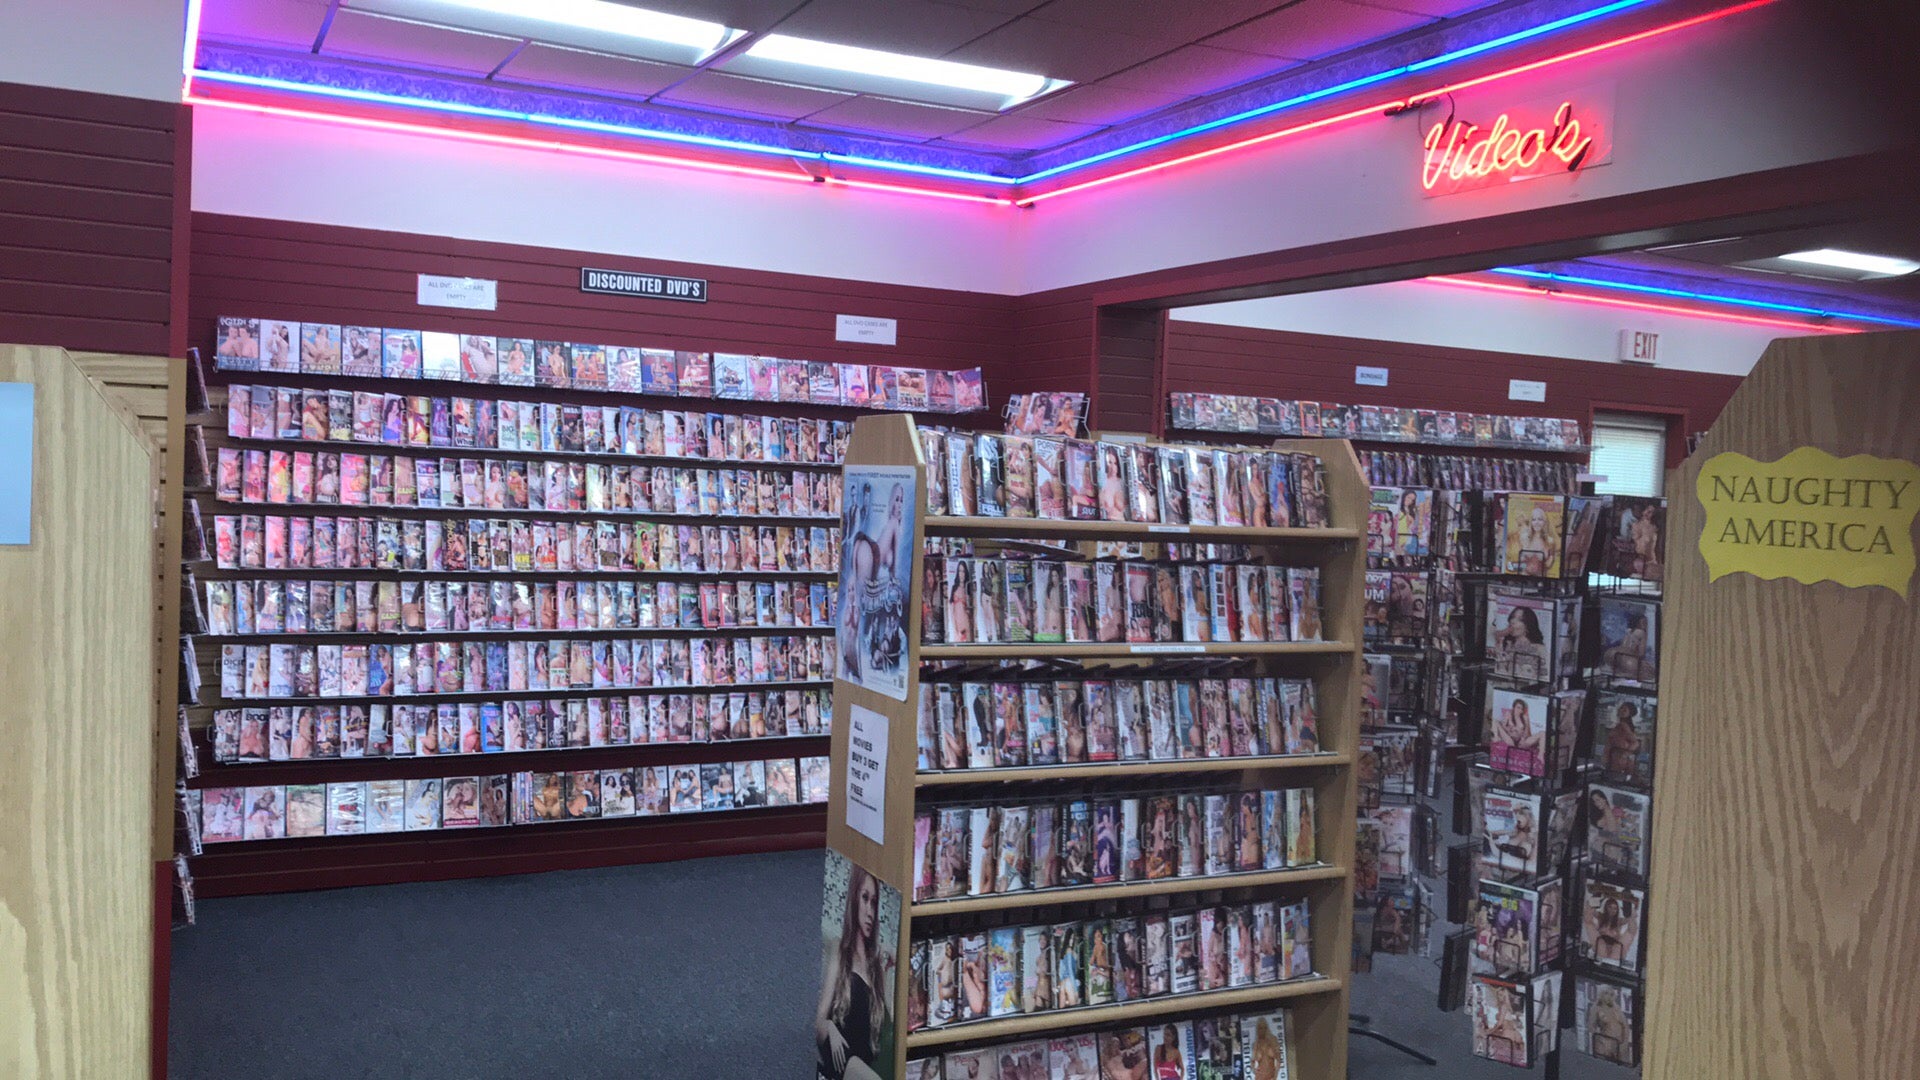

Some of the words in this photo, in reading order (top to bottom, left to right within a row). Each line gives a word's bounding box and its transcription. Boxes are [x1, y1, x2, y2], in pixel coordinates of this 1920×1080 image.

[1422, 101, 1592, 190] Video's
[588, 271, 662, 293] DISCOUNTED
[666, 279, 700, 297] DVD'S
[1634, 331, 1659, 360] EXIT
[1711, 475, 1912, 509] NAUGHTY
[1718, 517, 1896, 555] AMERICA
[854, 720, 864, 732] ALL
[853, 736, 872, 752] MOVIES
[852, 752, 863, 764] BUY
[868, 759, 879, 771] GET
[851, 767, 861, 780] THE
[850, 783, 864, 797] FREE
